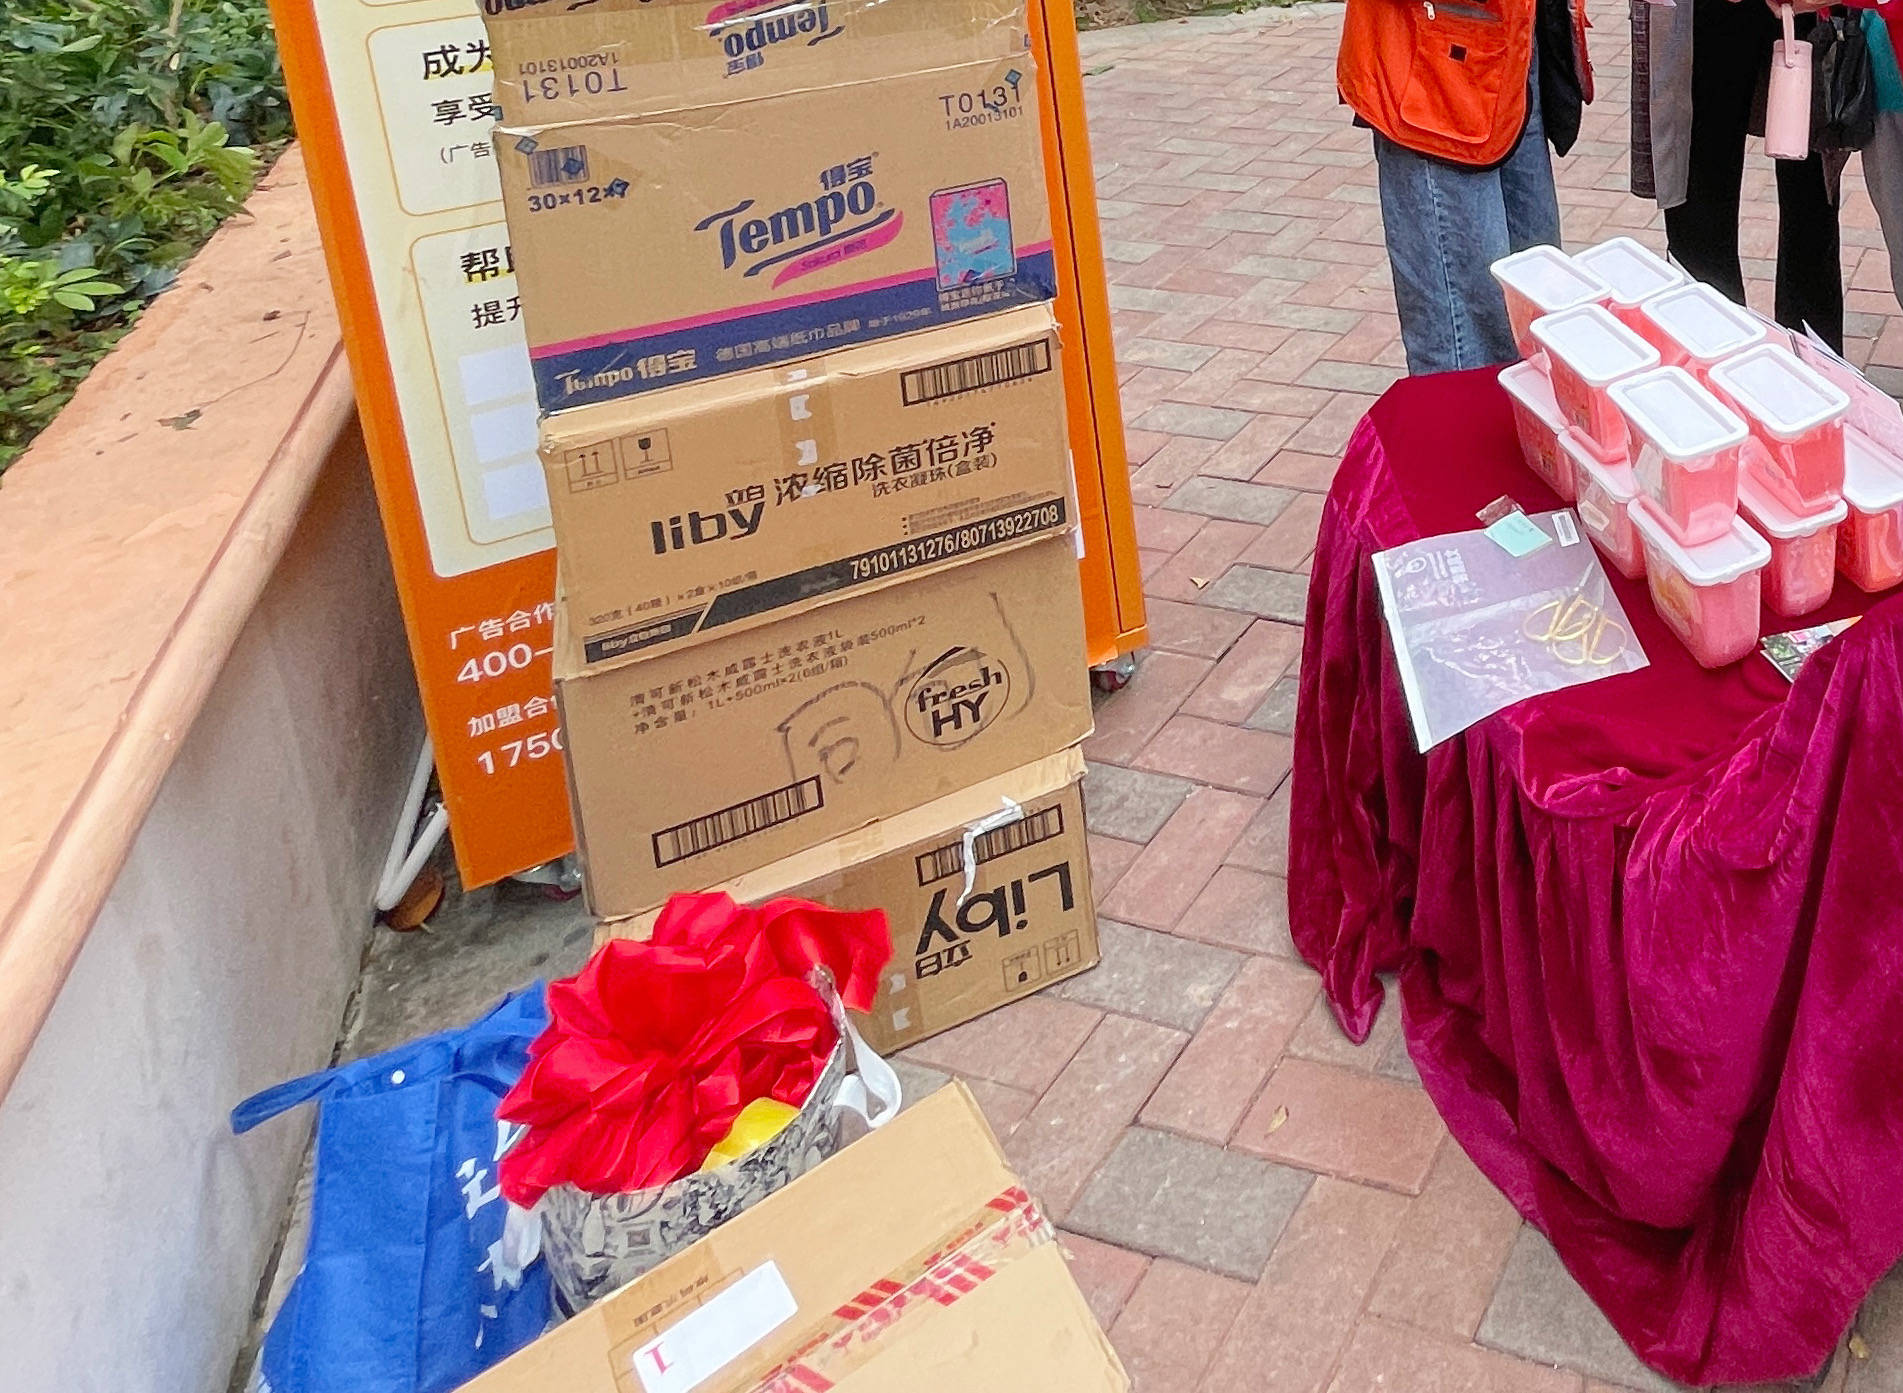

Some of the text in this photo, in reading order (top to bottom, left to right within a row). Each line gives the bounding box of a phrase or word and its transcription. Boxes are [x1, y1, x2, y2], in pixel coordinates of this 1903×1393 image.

[519, 51, 620, 76] 1A20013101
[523, 68, 628, 104] T0131
[938, 86, 1022, 117] T0131
[431, 92, 497, 127] 享受
[819, 154, 874, 192] 得宝
[693, 180, 877, 271] Tempo
[459, 245, 516, 283] 帮
[636, 348, 698, 380] 得宝
[650, 501, 768, 556] liby
[850, 504, 1061, 582] 79101131276/80713922708
[449, 601, 556, 651] 广告合作
[917, 665, 1003, 713] fresh
[467, 695, 558, 738] 加盟合
[931, 692, 992, 738] HY
[915, 860, 1075, 956] Liby
